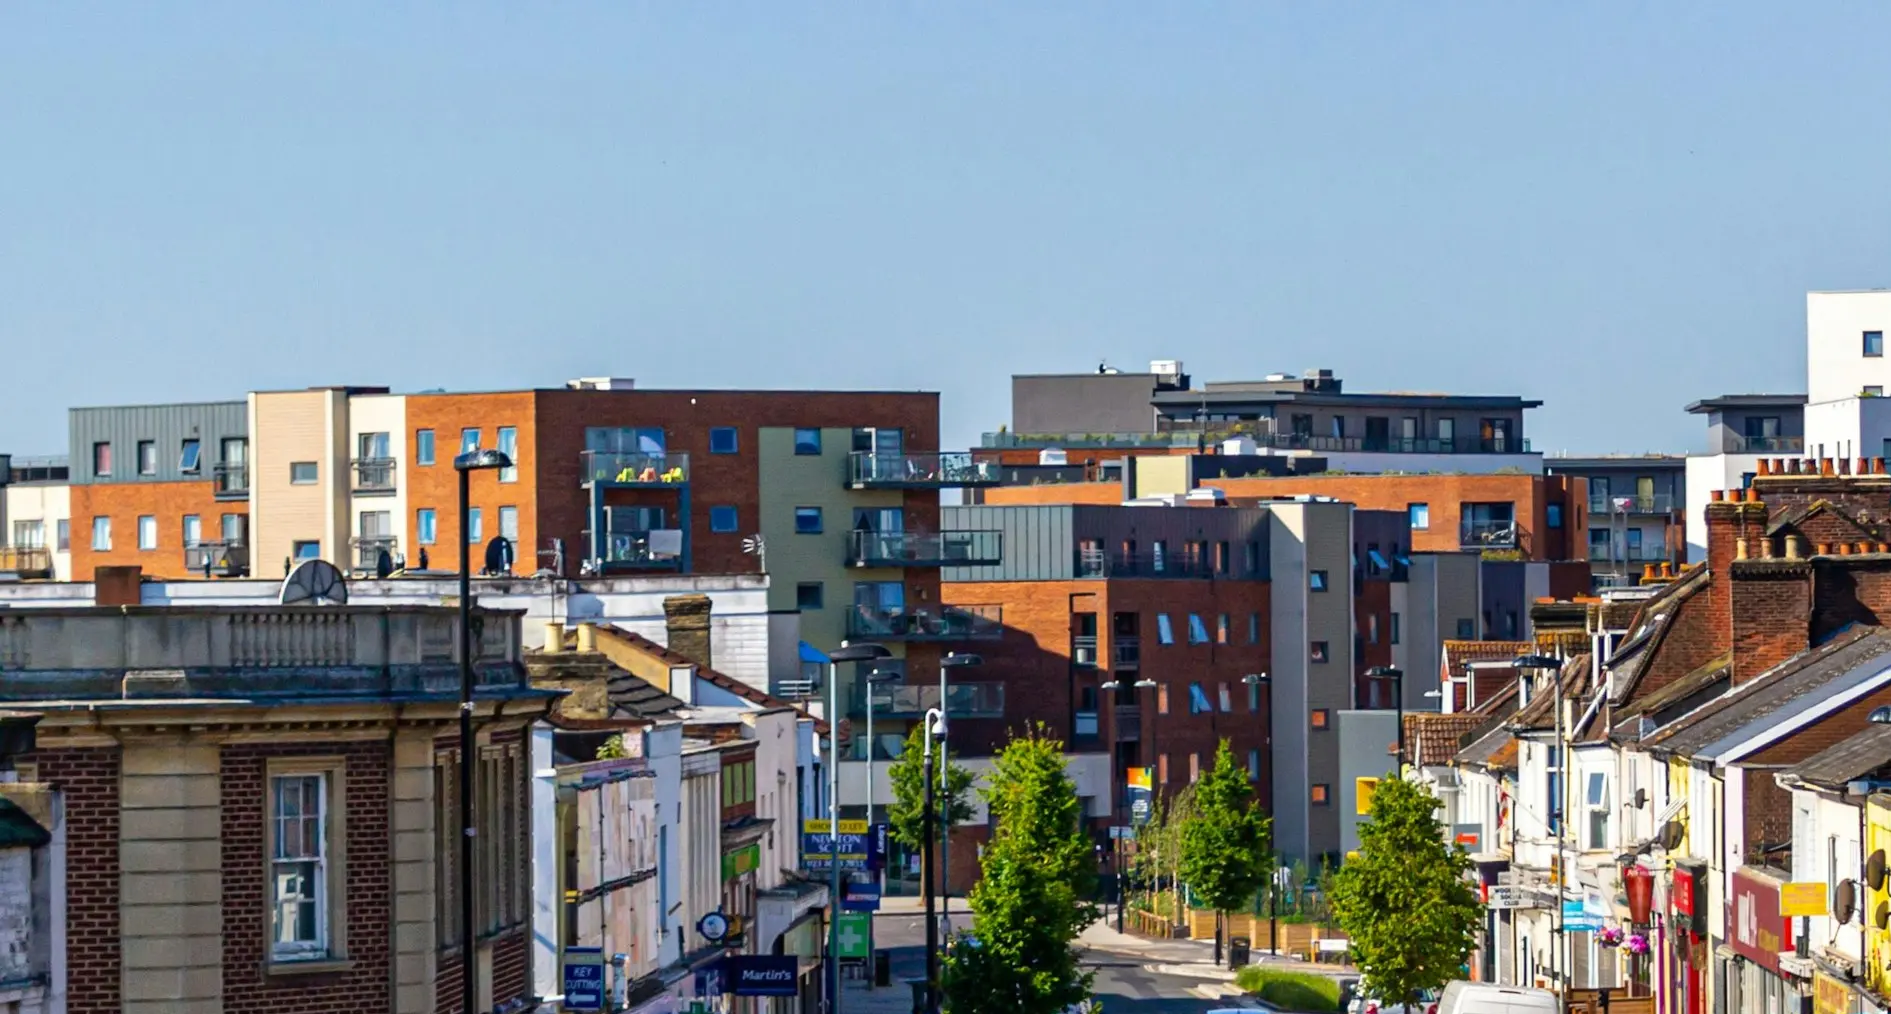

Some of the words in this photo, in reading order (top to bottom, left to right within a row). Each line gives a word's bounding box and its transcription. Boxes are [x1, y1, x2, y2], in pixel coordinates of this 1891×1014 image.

[818, 843, 853, 853] SCTT
[573, 966, 593, 977] KEY
[742, 969, 792, 981] Martin's
[565, 979, 600, 990] CUTTING
